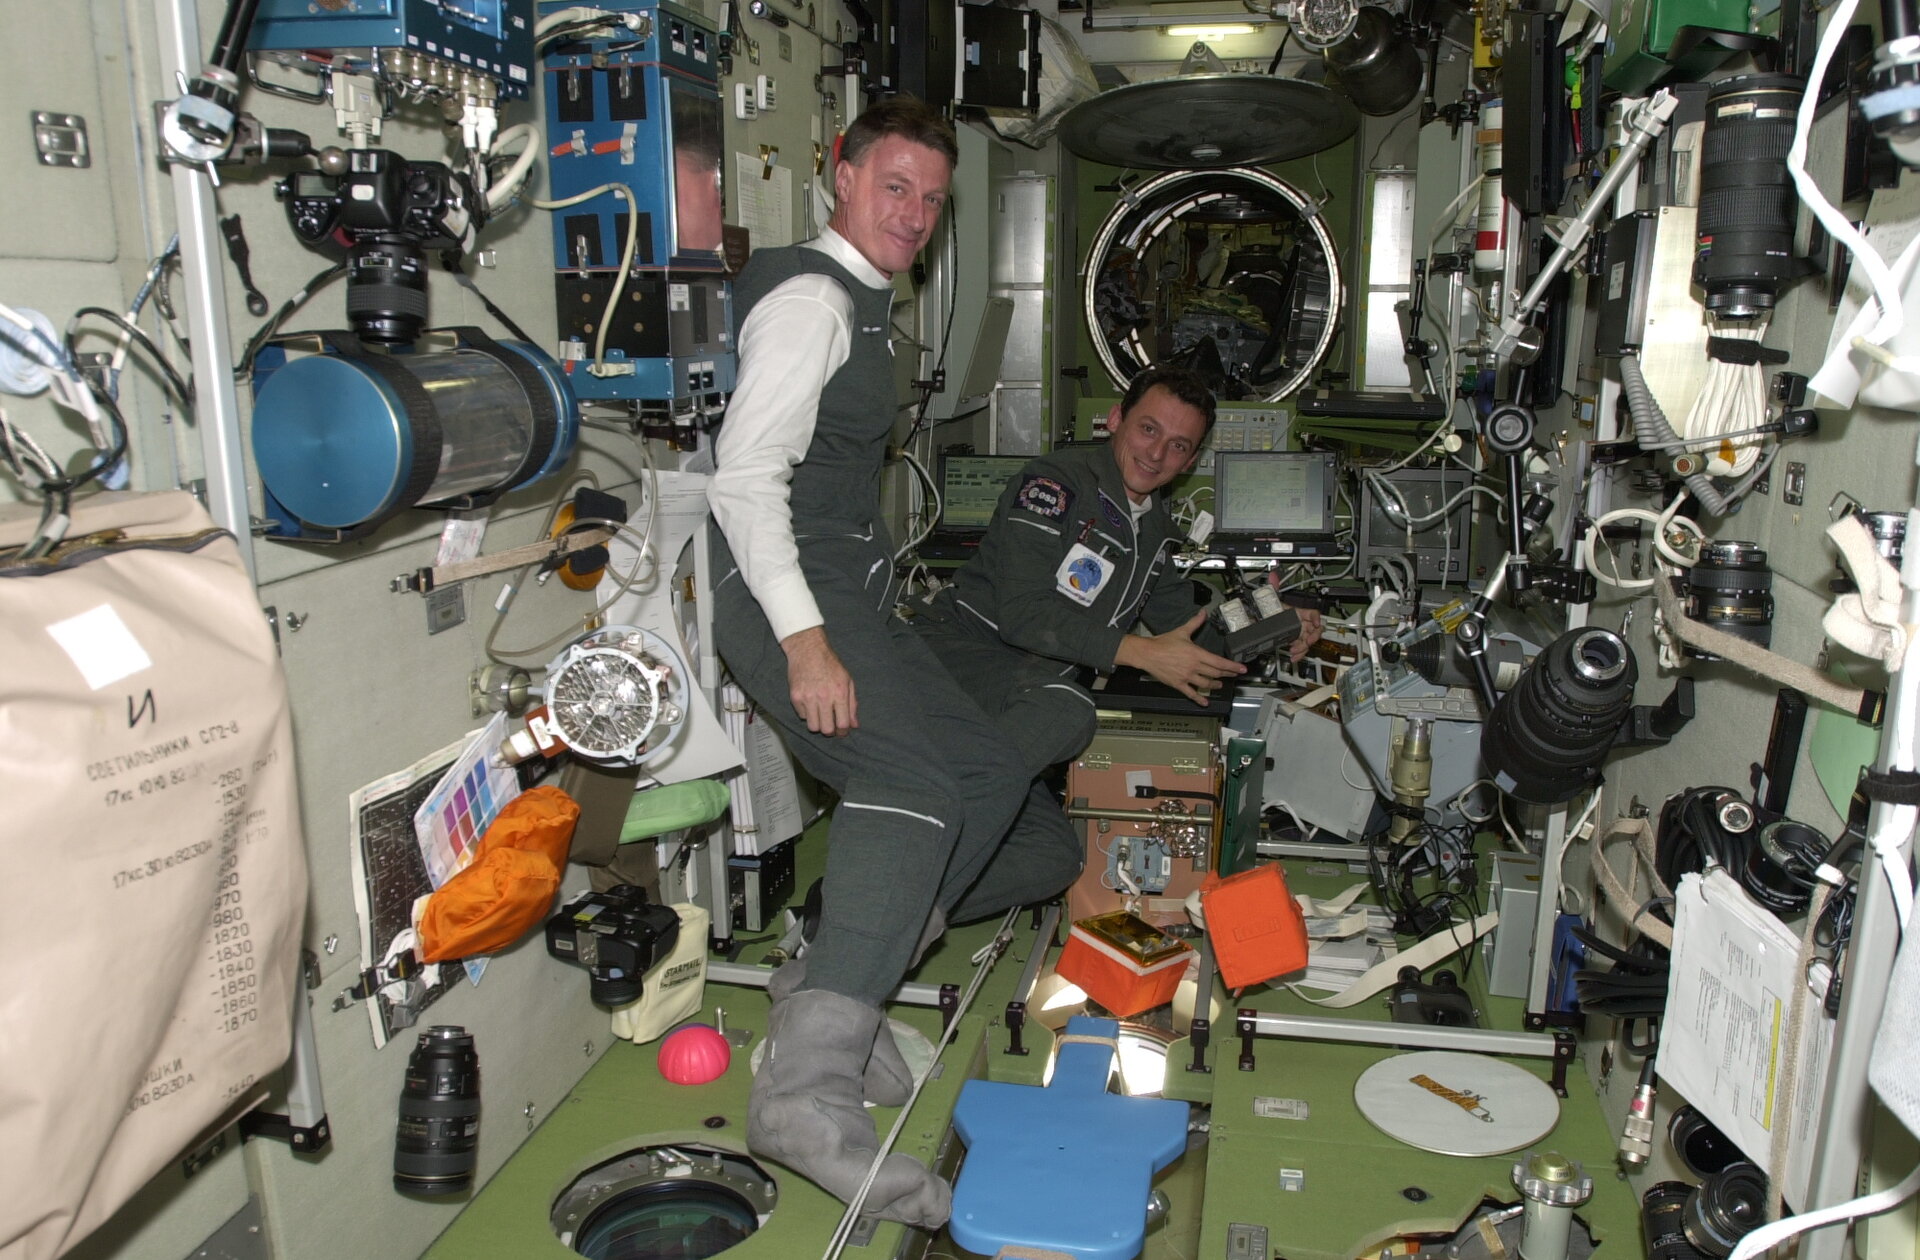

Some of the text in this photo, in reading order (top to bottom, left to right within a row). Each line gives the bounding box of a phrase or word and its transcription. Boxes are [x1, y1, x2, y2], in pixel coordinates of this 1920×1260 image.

[86, 736, 191, 781] СВЕТИЛЬНИКИ
[206, 923, 250, 945] -1820
[207, 940, 253, 962] -1830
[209, 957, 255, 980] -1840
[210, 975, 256, 998] -1850
[213, 993, 256, 1016] -1860
[215, 1009, 257, 1034] -1870
